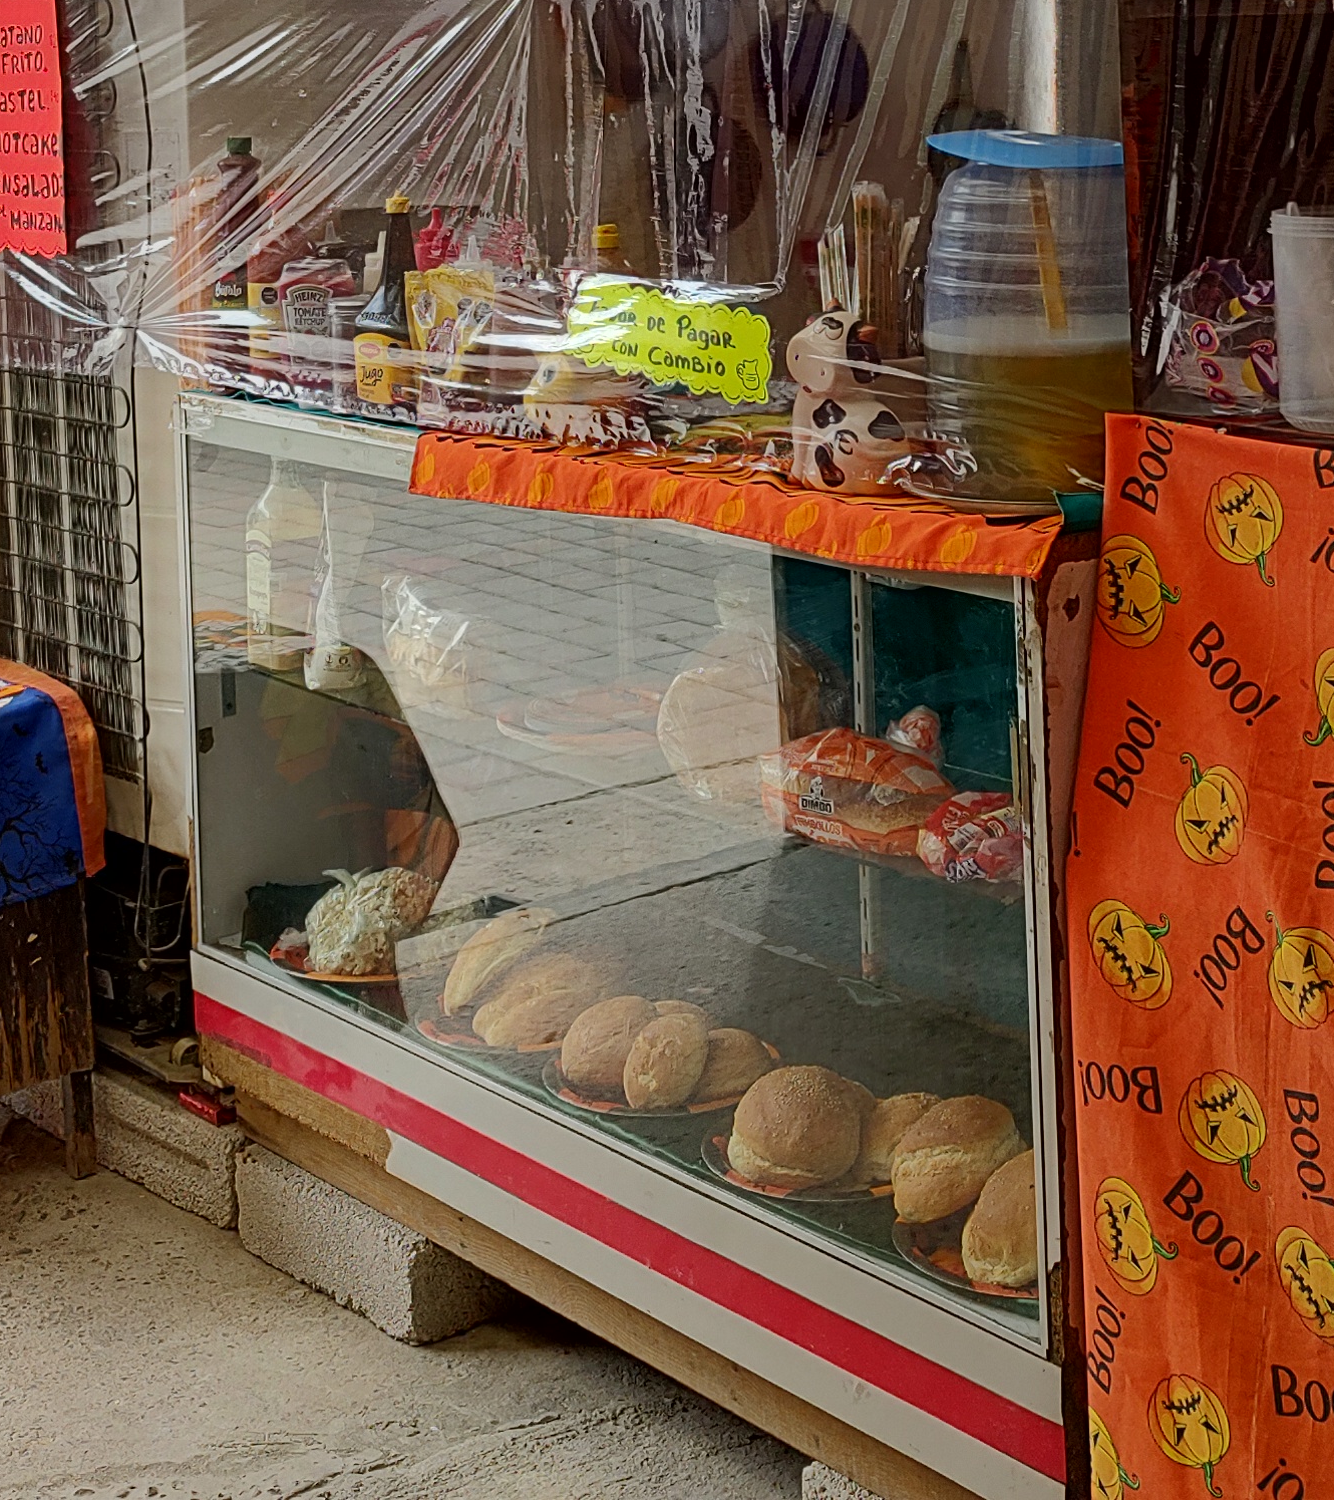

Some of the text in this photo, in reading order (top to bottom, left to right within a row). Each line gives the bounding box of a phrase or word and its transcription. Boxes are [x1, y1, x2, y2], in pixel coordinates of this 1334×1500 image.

[294, 292, 324, 303] HEINZ
[293, 307, 326, 318] TOMATE
[677, 314, 735, 350] PagaR
[612, 340, 638, 358] CON
[360, 366, 384, 387] Jugo
